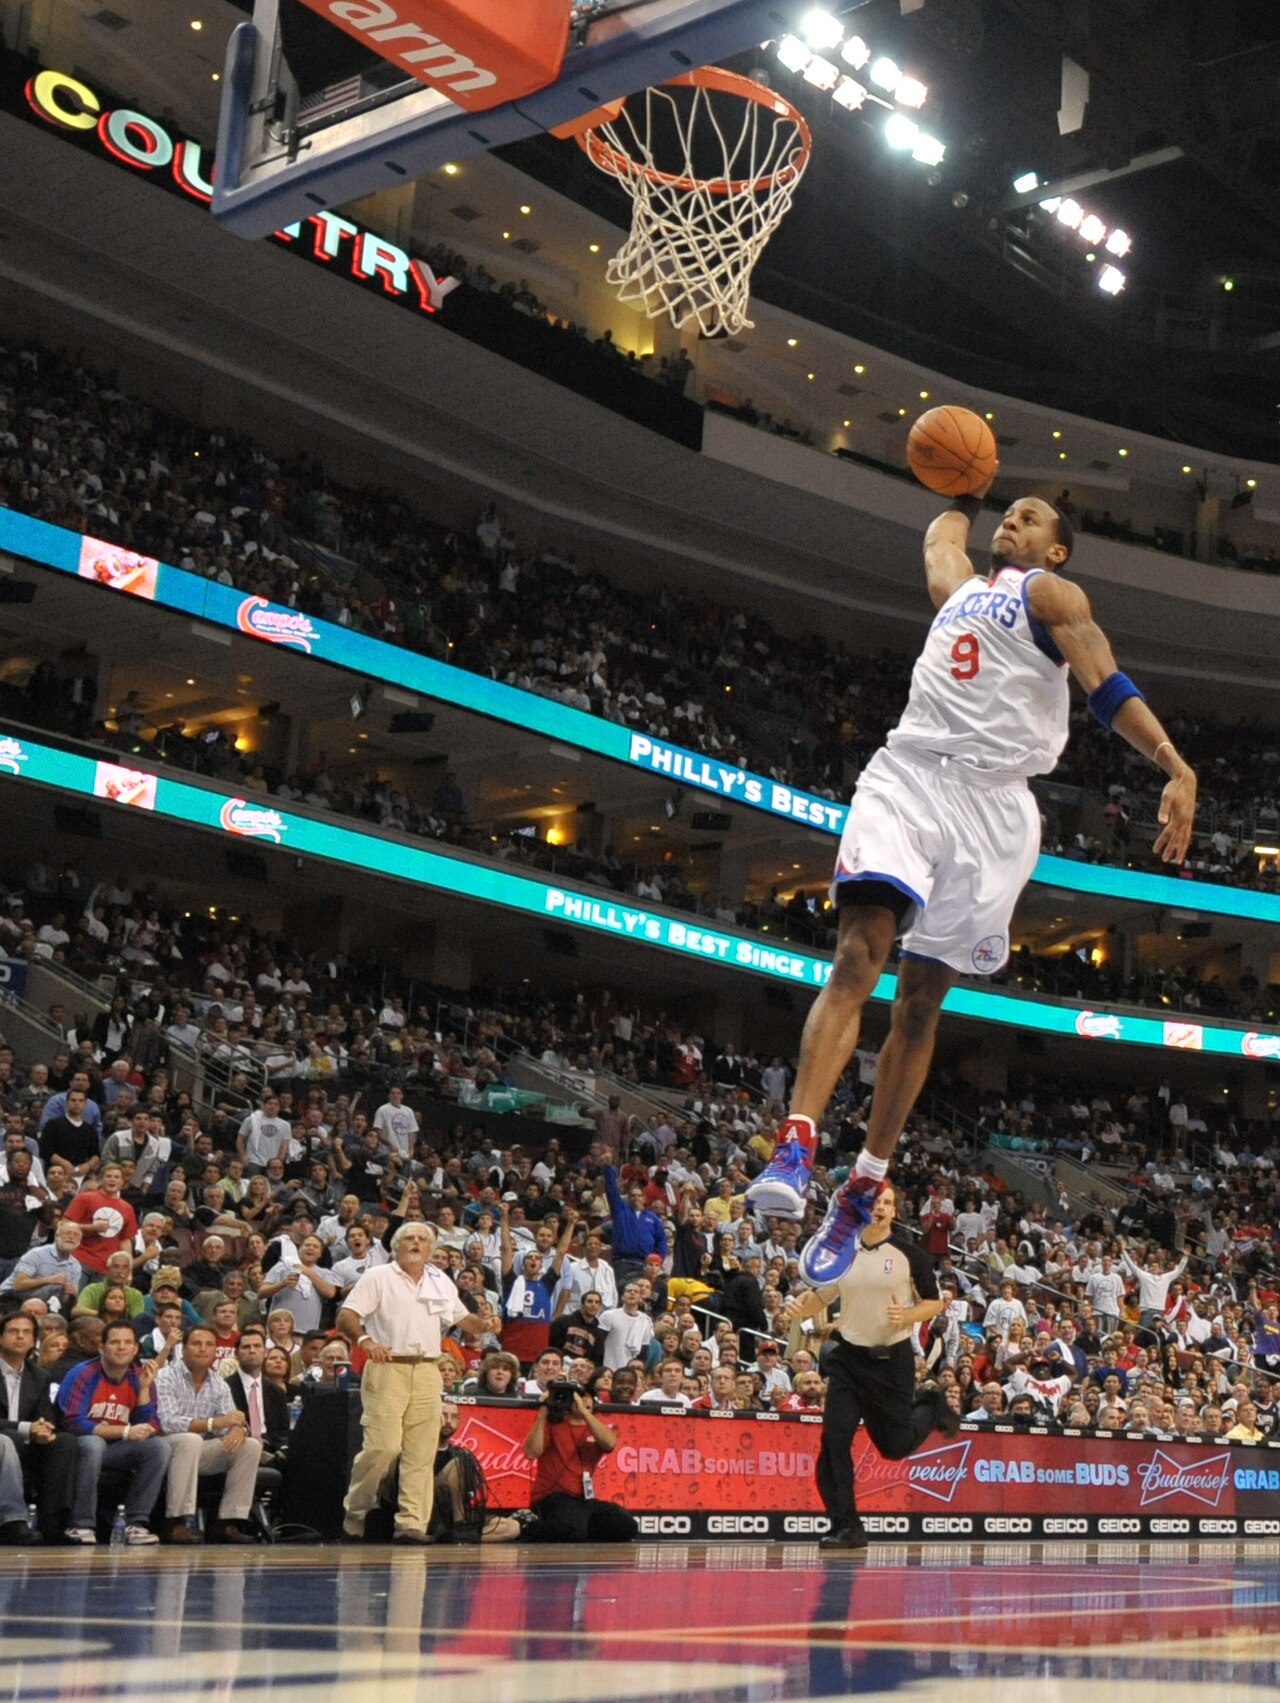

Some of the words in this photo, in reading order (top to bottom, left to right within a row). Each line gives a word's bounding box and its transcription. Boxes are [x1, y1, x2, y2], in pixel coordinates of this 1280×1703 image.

[25, 70, 462, 313] COUTRY
[951, 633, 979, 680] 9
[630, 733, 762, 803] PHILLY'S
[771, 785, 841, 829] BEST
[546, 889, 660, 939] PHILLY'S
[668, 923, 730, 949] BEST
[735, 942, 804, 979] SINCE
[616, 1446, 701, 1474] GRAB
[704, 1458, 756, 1475] SOME
[758, 1451, 815, 1477] BUD
[974, 1459, 1035, 1483] GRAB
[1036, 1469, 1074, 1484] SOME
[1075, 1463, 1130, 1486] BUDS
[1137, 1462, 1230, 1491] Budweiser
[1234, 1469, 1280, 1490] GRAB
[708, 1516, 769, 1533] GEICO
[784, 1516, 831, 1533] GEIC
[922, 1517, 973, 1533] GEICO
[984, 1517, 1032, 1533] GEICO
[1043, 1518, 1088, 1533] GEICO
[1098, 1518, 1141, 1533] GEICO
[1150, 1519, 1190, 1533] GEICO
[1199, 1519, 1238, 1533] GEICO
[1244, 1520, 1280, 1534] GEICO
